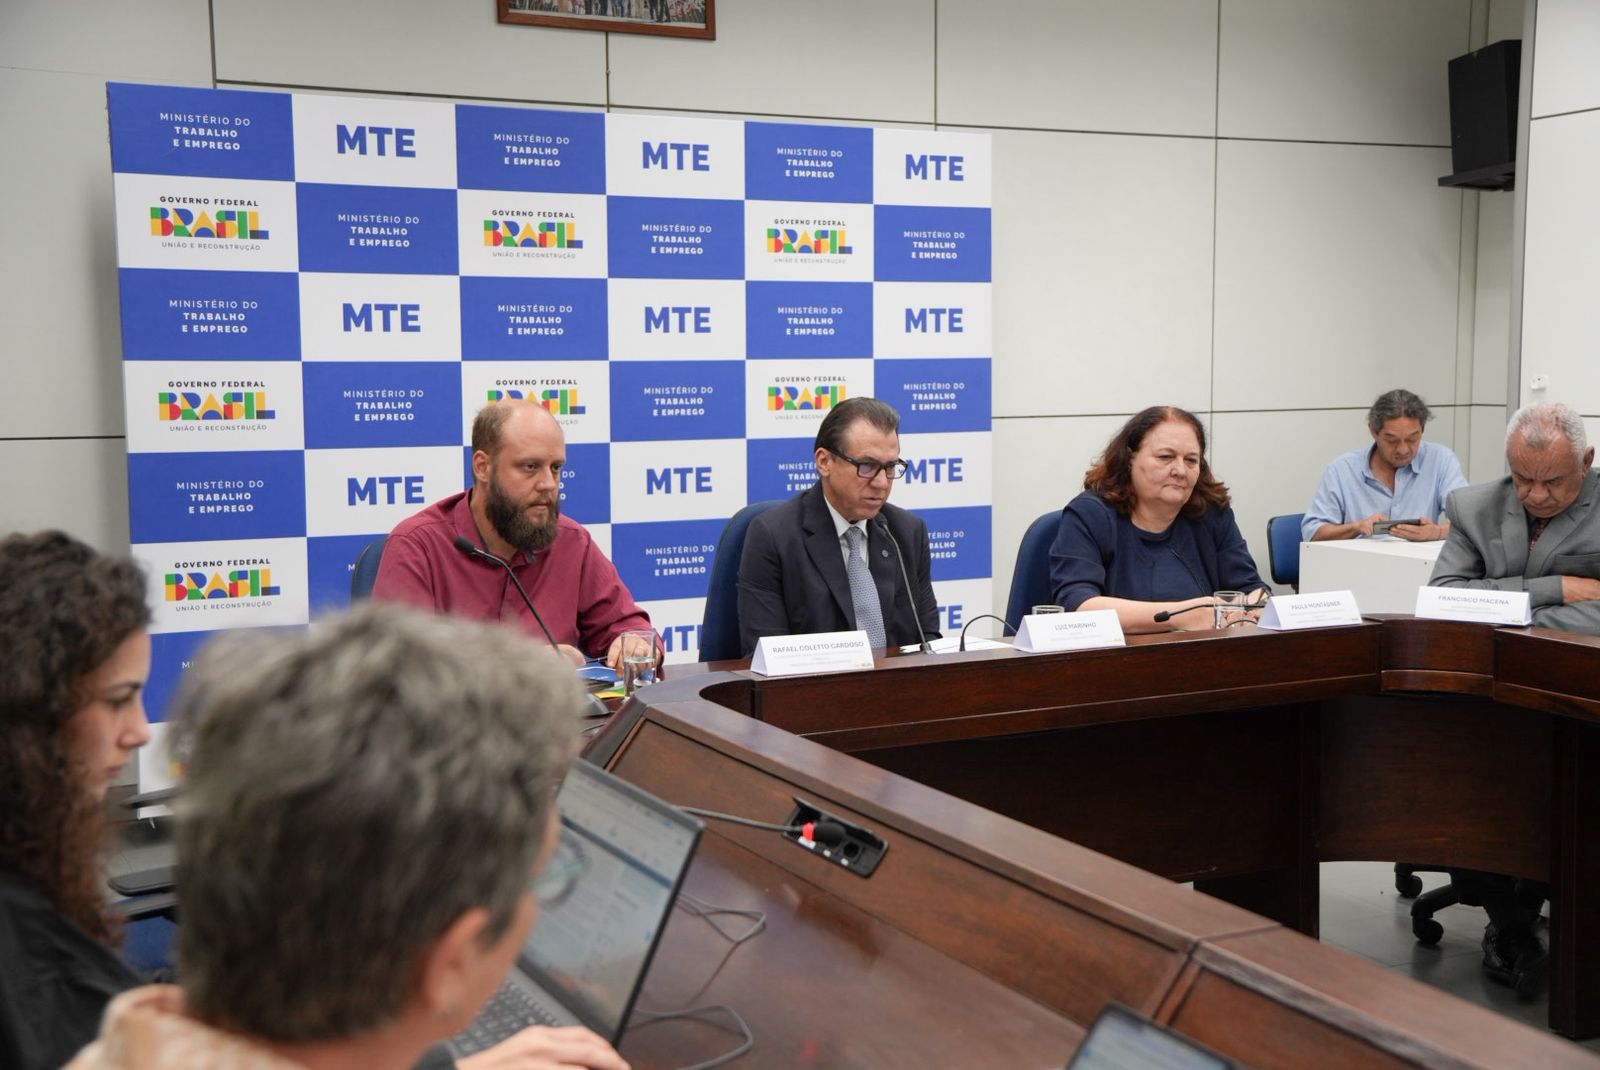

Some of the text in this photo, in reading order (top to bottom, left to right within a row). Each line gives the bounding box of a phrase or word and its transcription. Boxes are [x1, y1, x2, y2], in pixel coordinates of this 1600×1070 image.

[160, 113, 250, 126] MINISTÉRIO DO
[174, 126, 237, 137] TRABALHO
[336, 124, 416, 158] MTE
[494, 134, 552, 143] MINISTÉRIO
[173, 139, 240, 150] E EMPREGO
[506, 146, 558, 155] TRABALHO
[777, 148, 827, 157] MINISTÉRIO
[642, 142, 709, 171] MTE
[514, 158, 560, 166] EMPREGO
[787, 159, 833, 167] TRABALHO
[906, 154, 964, 181] MTE
[794, 170, 834, 178] EMPREGO
[160, 196, 209, 204] GOVERNO
[338, 214, 400, 223] MINISTÉRIO
[150, 207, 269, 240] BRASIL
[642, 224, 696, 232] MINISTÉRIO
[351, 226, 407, 235] TRABALHO
[484, 220, 583, 249] BRASIL
[349, 238, 409, 247] E EMPREGO
[767, 228, 852, 254] BRASIL
[170, 299, 258, 309] MINISTÉRIO DO
[498, 304, 555, 312] MINISTÉRIO
[778, 306, 828, 314] MINISTÉRIO
[183, 313, 245, 321] TRABALHO
[343, 303, 421, 332] MTE
[509, 316, 561, 324] TRABALHO
[645, 307, 711, 333] MTE
[905, 308, 963, 333] MTE
[193, 325, 247, 333] EMPREGO
[644, 386, 697, 394] MINISTÉRIO
[904, 382, 951, 390] MINISTÉRIO
[344, 389, 405, 398] MINISTÉRIO
[158, 392, 275, 420] BRASIL
[662, 408, 704, 416] EMPREGO
[365, 413, 414, 421] EMPREGO
[779, 461, 816, 470] MINISTÉ
[905, 458, 963, 483] MTE
[177, 480, 264, 489] MINISTÉRIO DO
[647, 466, 713, 495] MTE
[348, 476, 424, 506] MTE
[190, 493, 251, 501] TRABALHO
[189, 504, 253, 514] E EMPREGO
[646, 546, 698, 555] MINISTÉRIO
[656, 556, 704, 565] TRABALHO
[663, 567, 706, 575] EMPREGO
[165, 568, 280, 601] BRASIL
